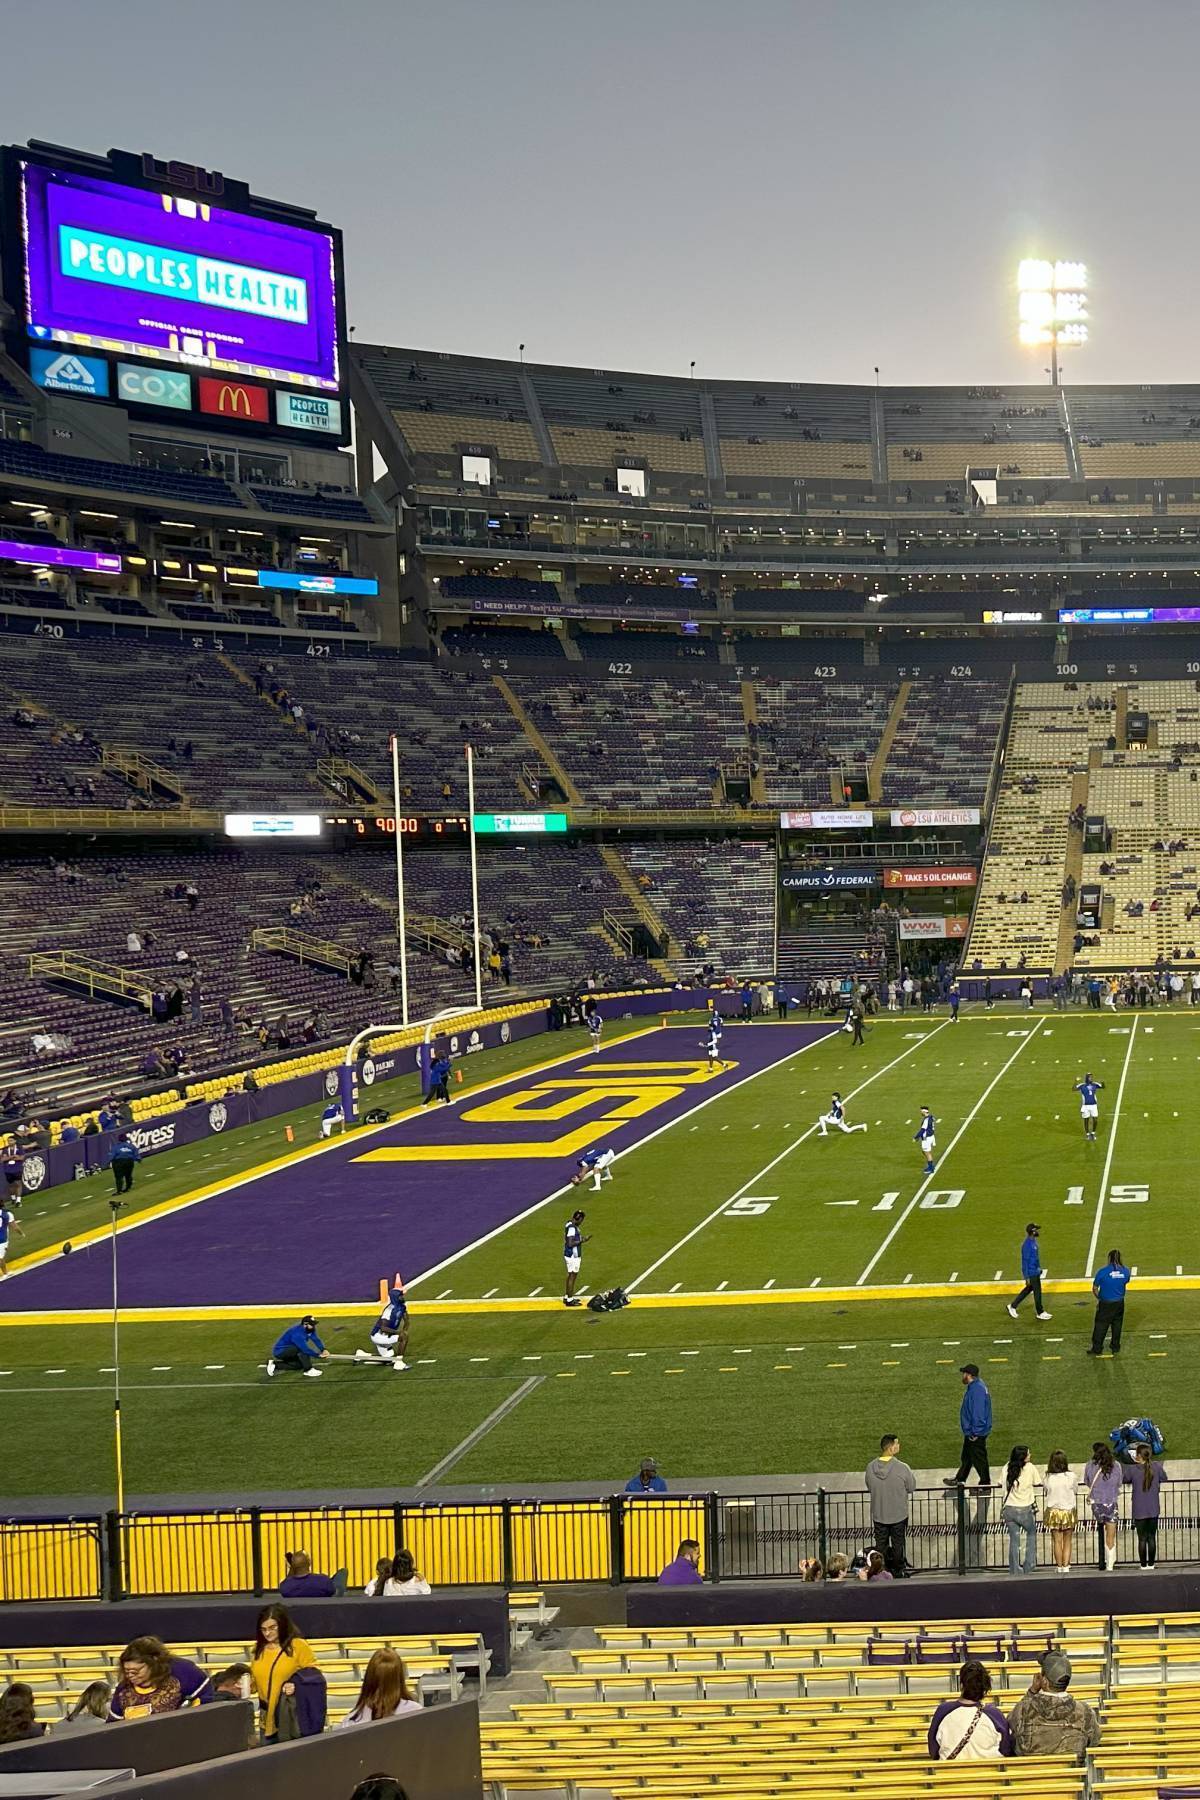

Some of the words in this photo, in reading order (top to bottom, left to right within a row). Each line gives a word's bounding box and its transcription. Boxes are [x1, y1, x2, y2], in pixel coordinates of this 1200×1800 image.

[142, 153, 224, 196] LSU
[69, 237, 193, 291] PEOPLES
[204, 268, 299, 313] HEALTH
[44, 378, 96, 394] Albertsons
[120, 371, 188, 401] COX
[291, 398, 327, 414] PEOPLES
[292, 413, 328, 427] HEALTH
[483, 602, 503, 610] NEED
[306, 645, 331, 657] 421
[608, 662, 633, 675] 422
[813, 666, 837, 678] 423
[950, 665, 972, 677] 424
[1056, 664, 1078, 676] 100
[917, 813, 932, 824] LSU
[933, 812, 973, 824] ATHLETICS
[783, 877, 820, 887] CAMPUS
[836, 876, 874, 885] FEDERAL
[904, 874, 923, 882] TAKE
[929, 873, 941, 881] OIL
[941, 872, 972, 881] CHANGE
[902, 922, 941, 930] WWL
[348, 1060, 740, 1163] LSU
[871, 1190, 966, 1211] 10
[1063, 1184, 1150, 1205] 15
[723, 1196, 780, 1216] 5
